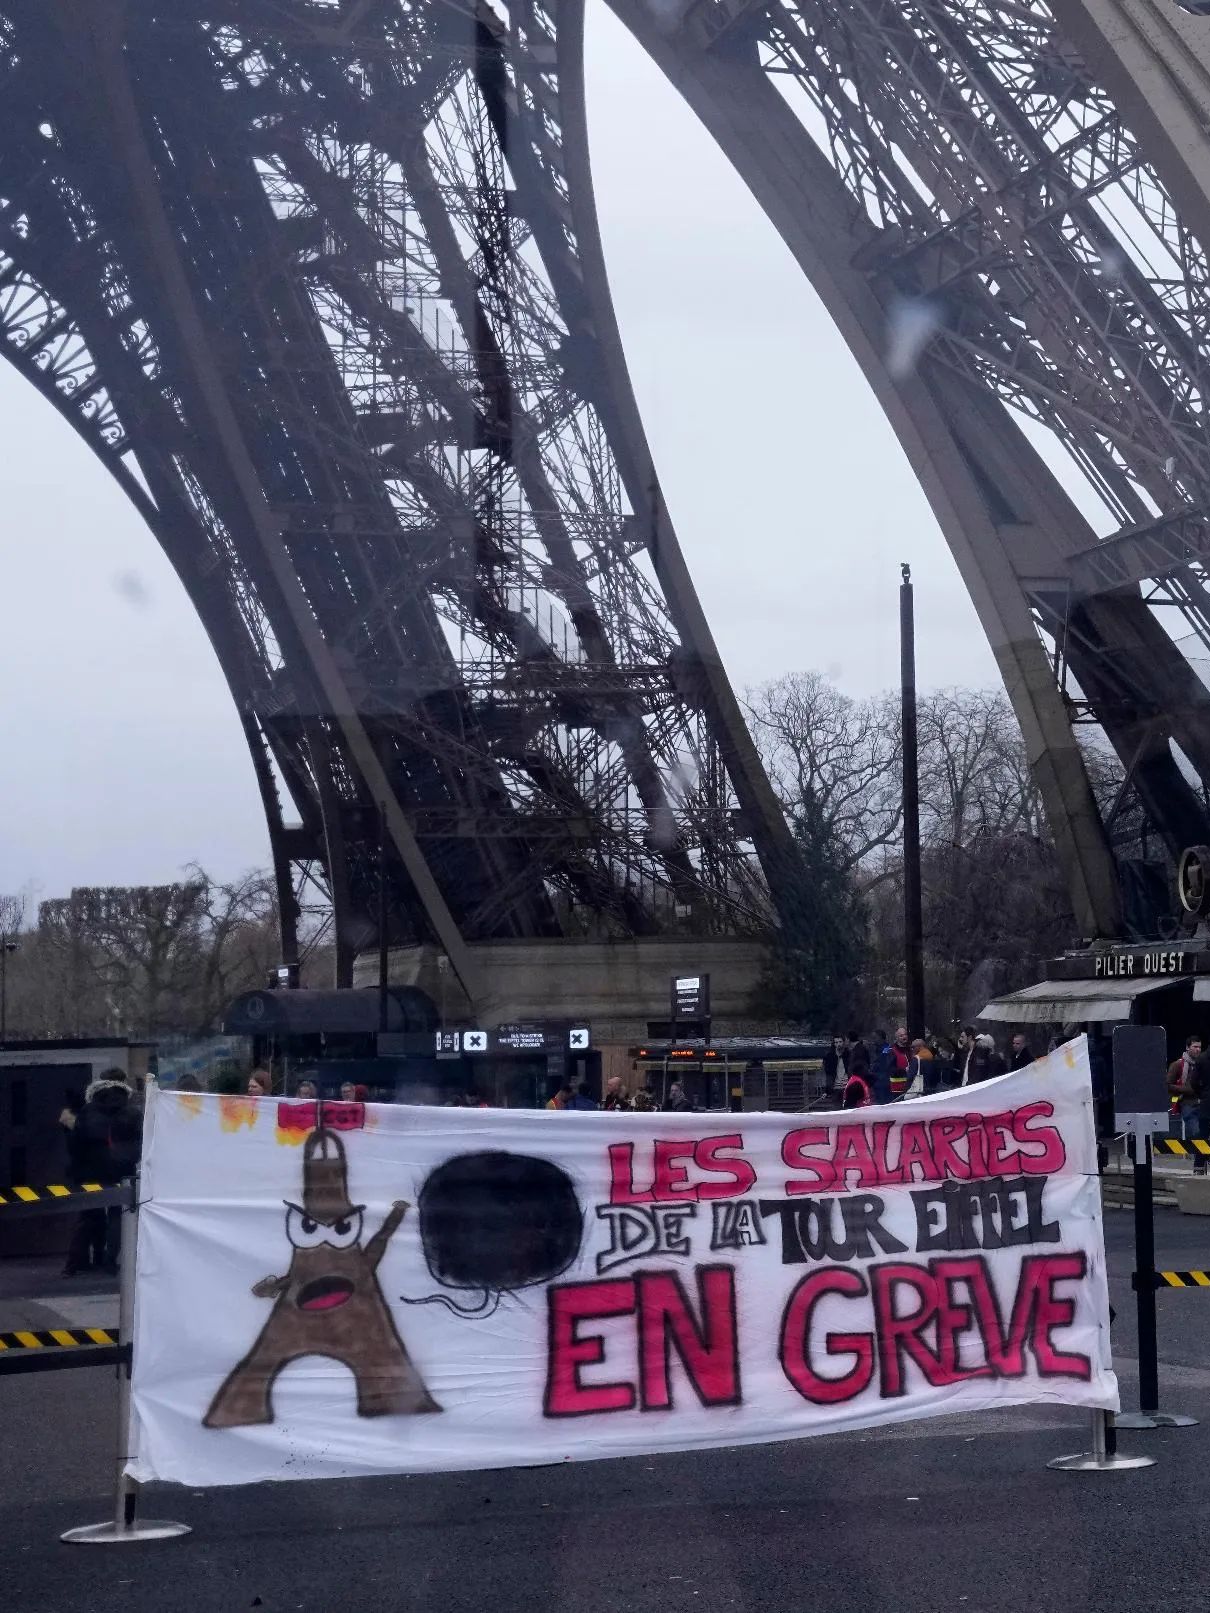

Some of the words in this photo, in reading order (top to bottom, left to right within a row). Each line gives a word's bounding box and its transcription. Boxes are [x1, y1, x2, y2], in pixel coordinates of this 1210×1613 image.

[1095, 955, 1134, 976] PILIER
[1144, 951, 1184, 973] OUEST
[323, 1109, 359, 1125] CGT
[608, 1134, 758, 1204] LES
[596, 1201, 697, 1272] DE
[710, 1199, 768, 1251] LA
[760, 1194, 909, 1265] TOUR
[543, 1263, 742, 1419] EN
[778, 1251, 1091, 1404] GREVE
